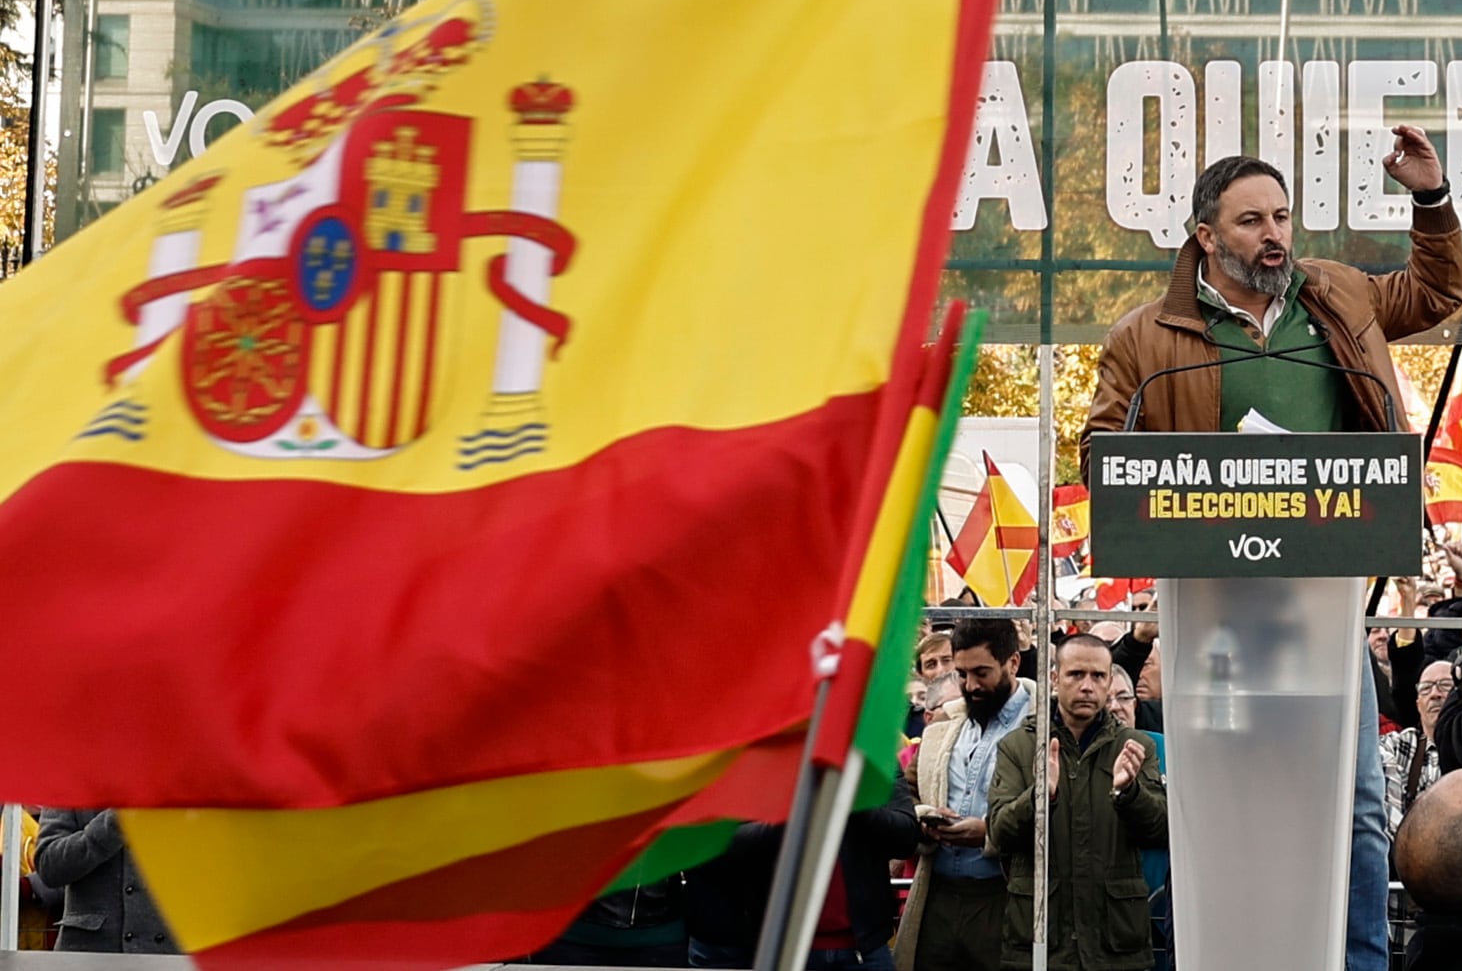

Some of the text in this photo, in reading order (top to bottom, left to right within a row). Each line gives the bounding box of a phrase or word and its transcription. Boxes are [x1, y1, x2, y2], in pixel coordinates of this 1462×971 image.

[143, 90, 256, 166] VO
[1220, 458, 1307, 487] QUIERE
[1315, 455, 1408, 485] VOTAR!
[1314, 489, 1361, 518] YA!
[1229, 533, 1282, 561] VOX
